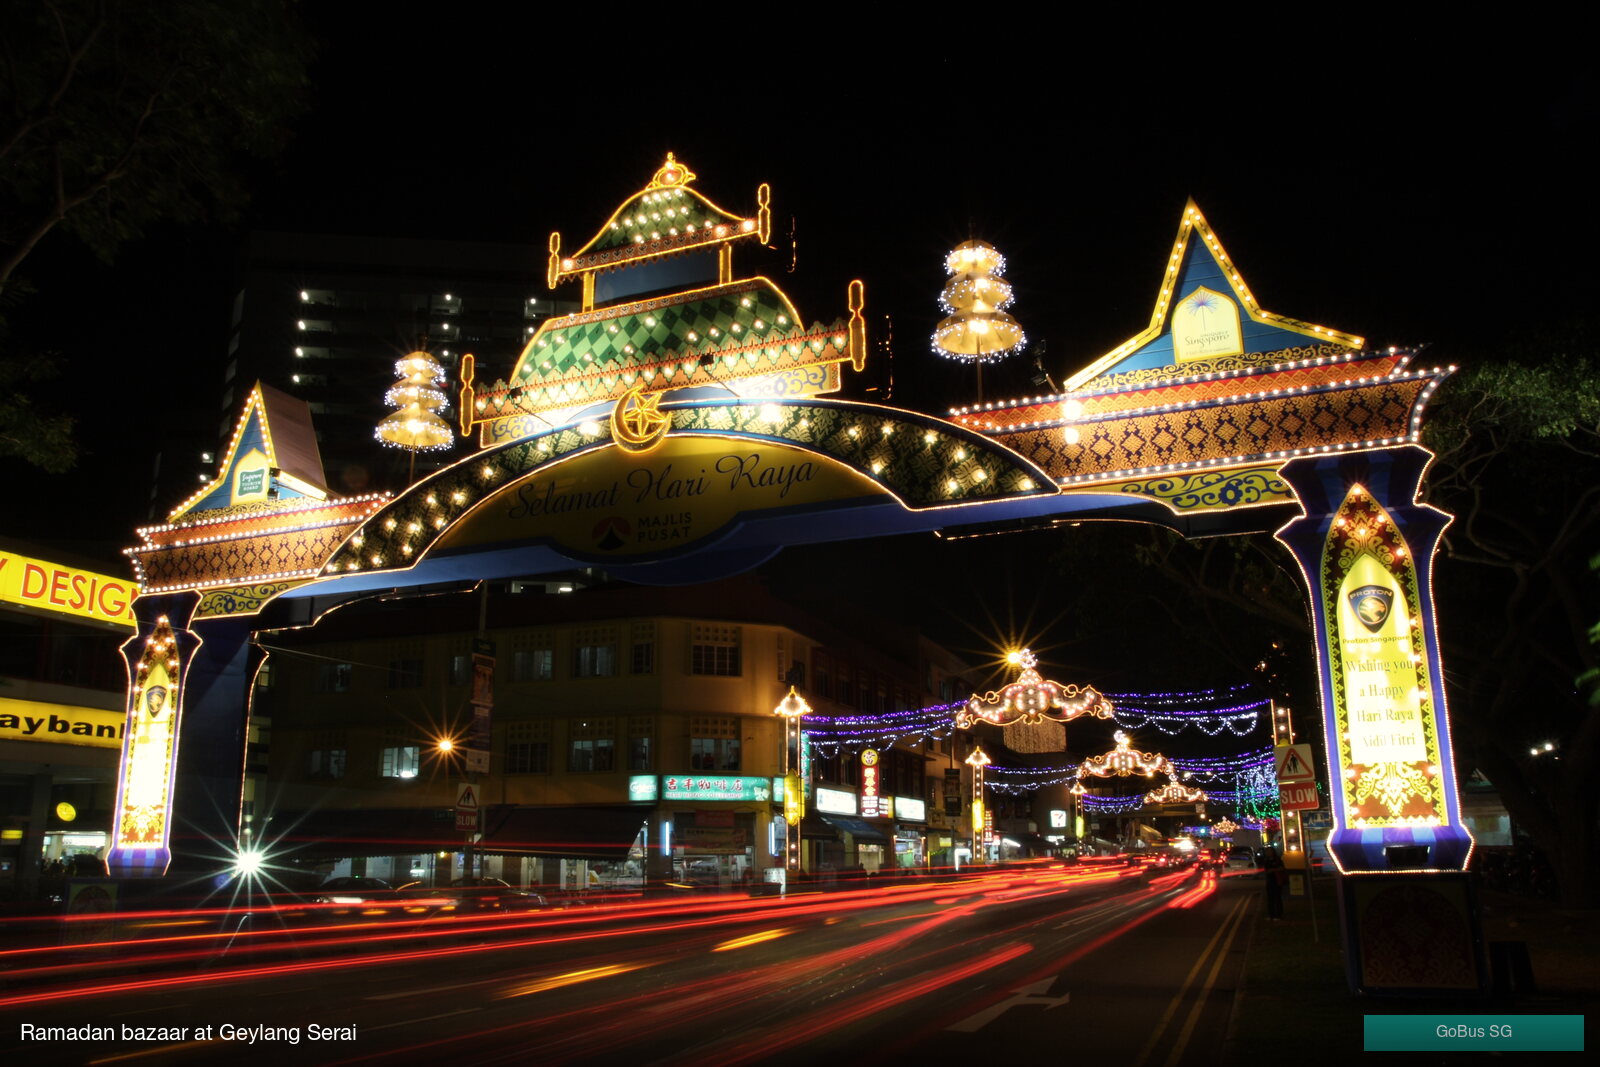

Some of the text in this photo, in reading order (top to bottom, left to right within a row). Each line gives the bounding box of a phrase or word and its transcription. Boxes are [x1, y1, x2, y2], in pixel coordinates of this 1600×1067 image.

[508, 453, 820, 519] Selamat Hari Raya
[638, 511, 692, 528] MAJLIS
[638, 526, 690, 541] PUSAT
[1349, 589, 1392, 600] PROTON
[1371, 635, 1410, 643] Singapore
[1345, 659, 1413, 674] Wishing you
[1359, 684, 1405, 701] a Happy
[1385, 708, 1414, 724] Raya
[1281, 788, 1315, 804] SLOW
[456, 815, 476, 826] SLOW
